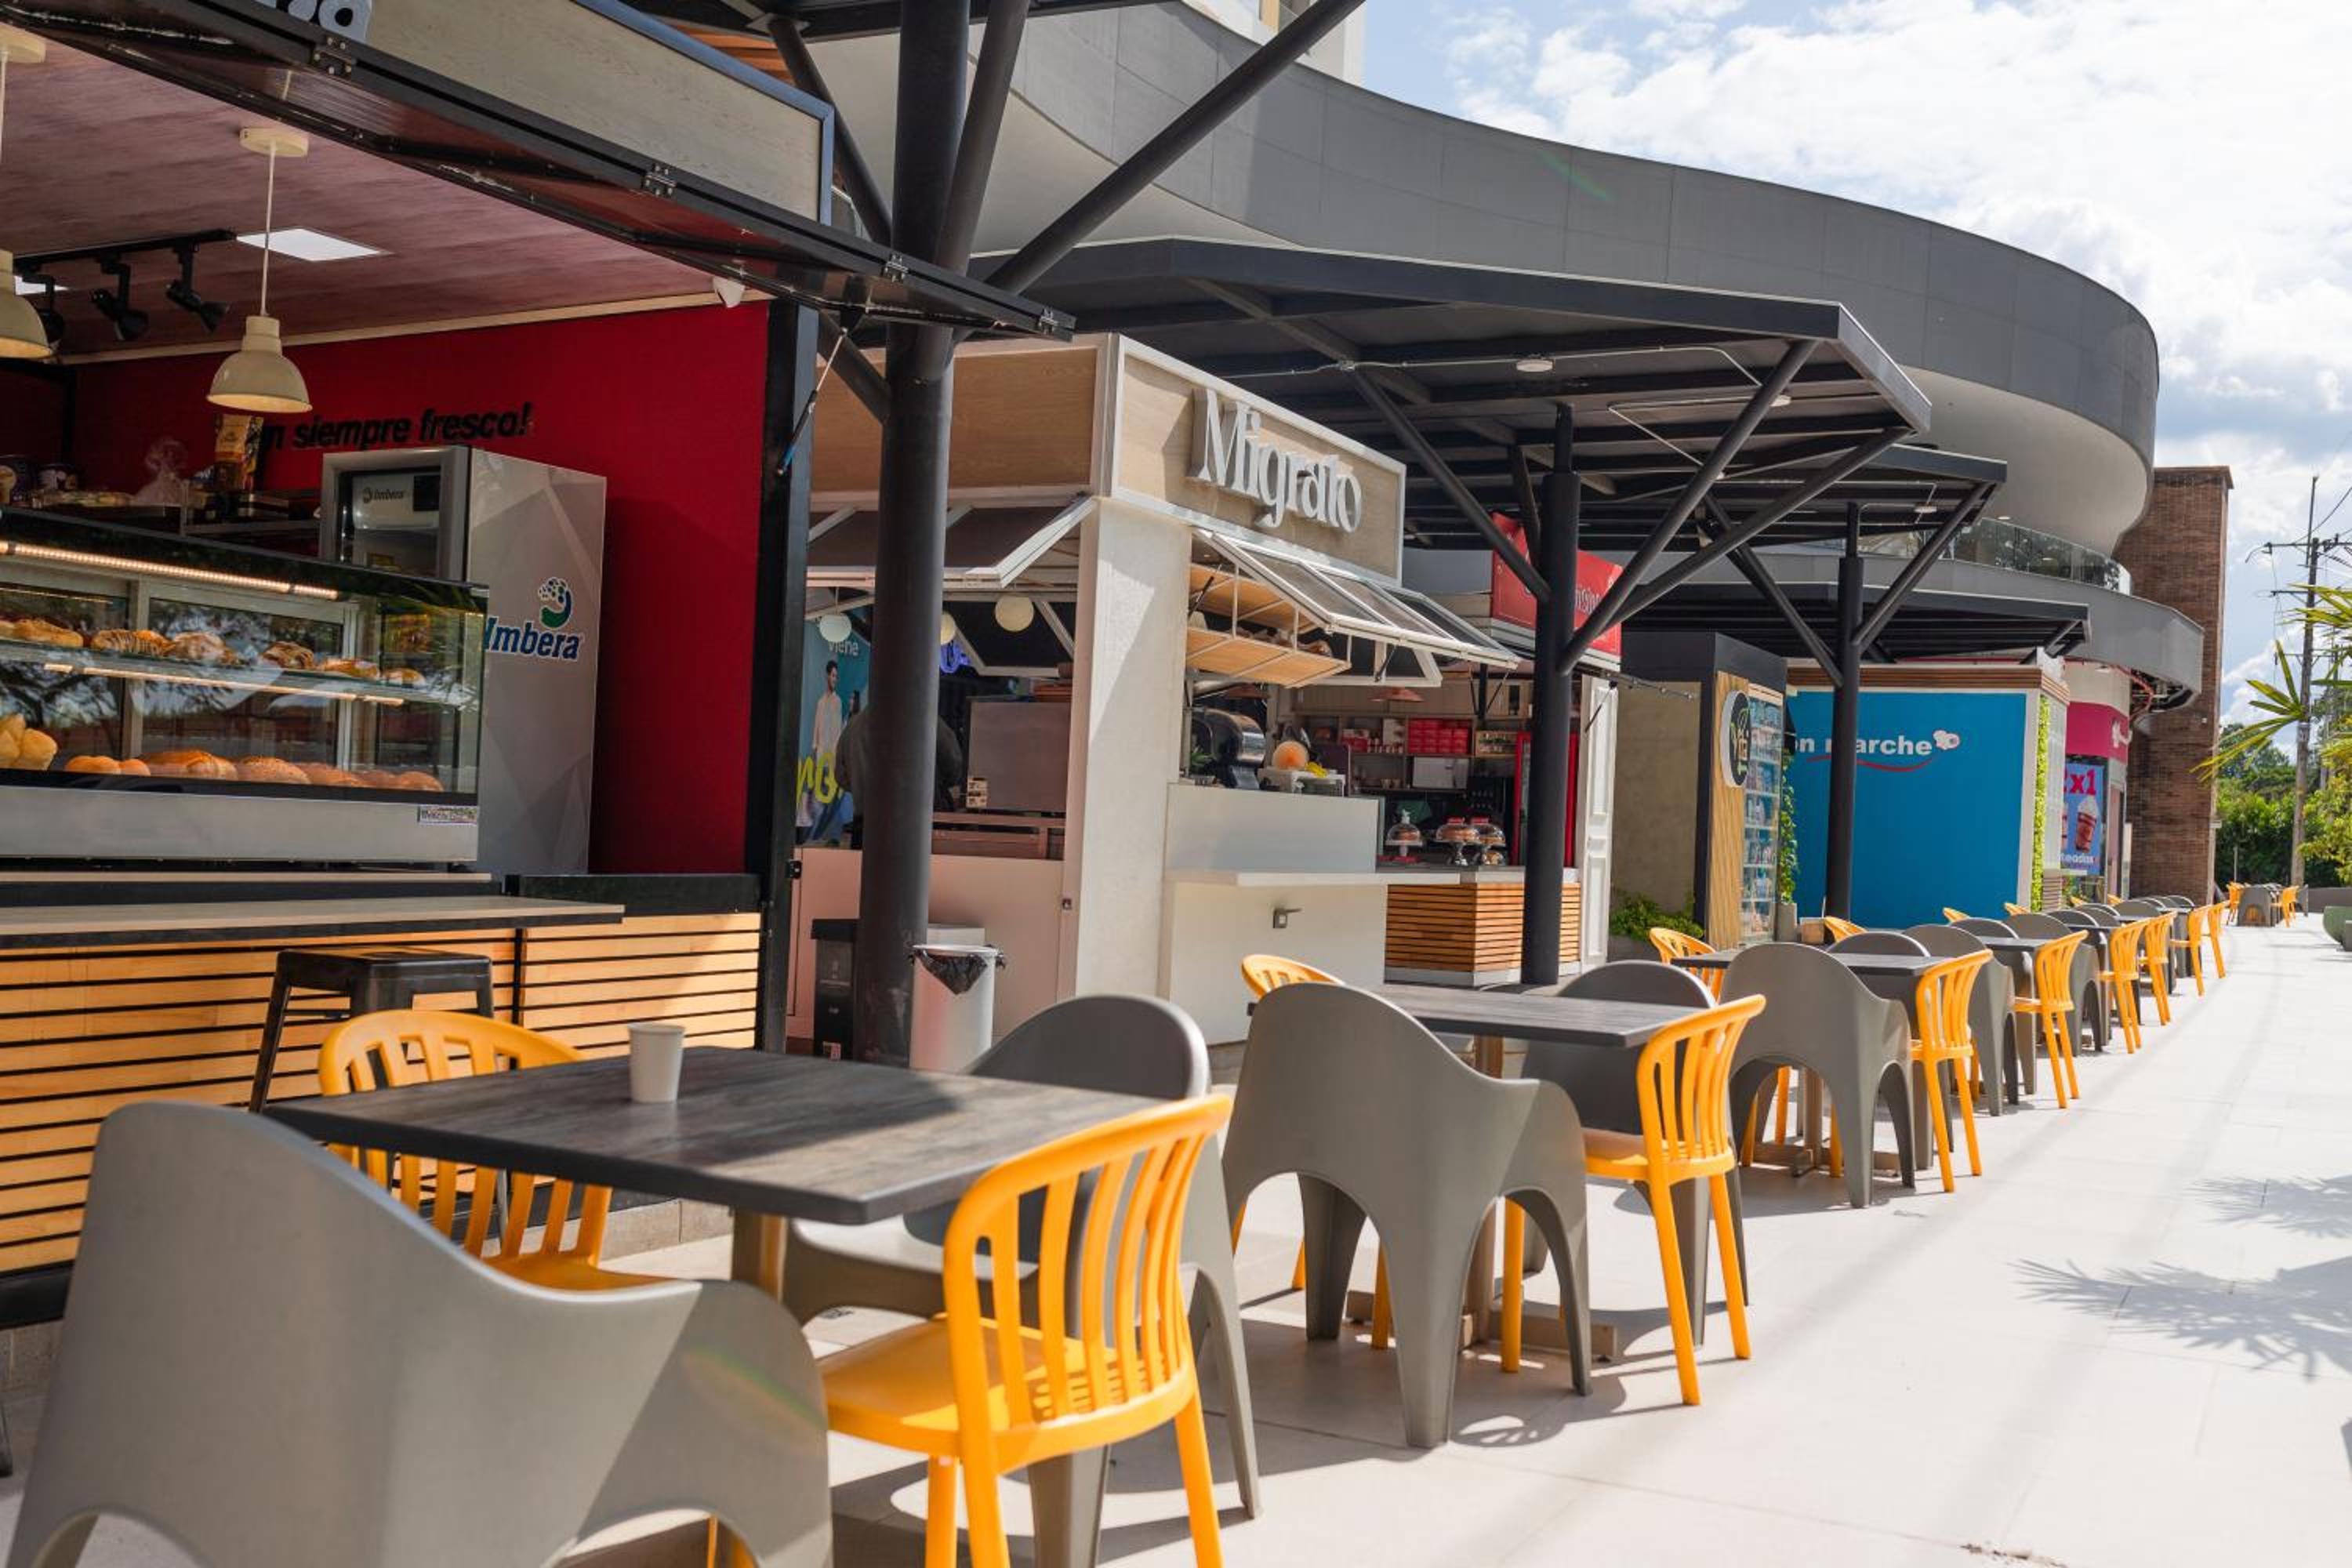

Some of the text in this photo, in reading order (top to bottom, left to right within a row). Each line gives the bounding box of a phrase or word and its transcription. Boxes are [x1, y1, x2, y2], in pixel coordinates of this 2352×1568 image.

[293, 416, 412, 450] siempre
[420, 401, 532, 441] fresco!
[1196, 389, 1362, 533] Migrato
